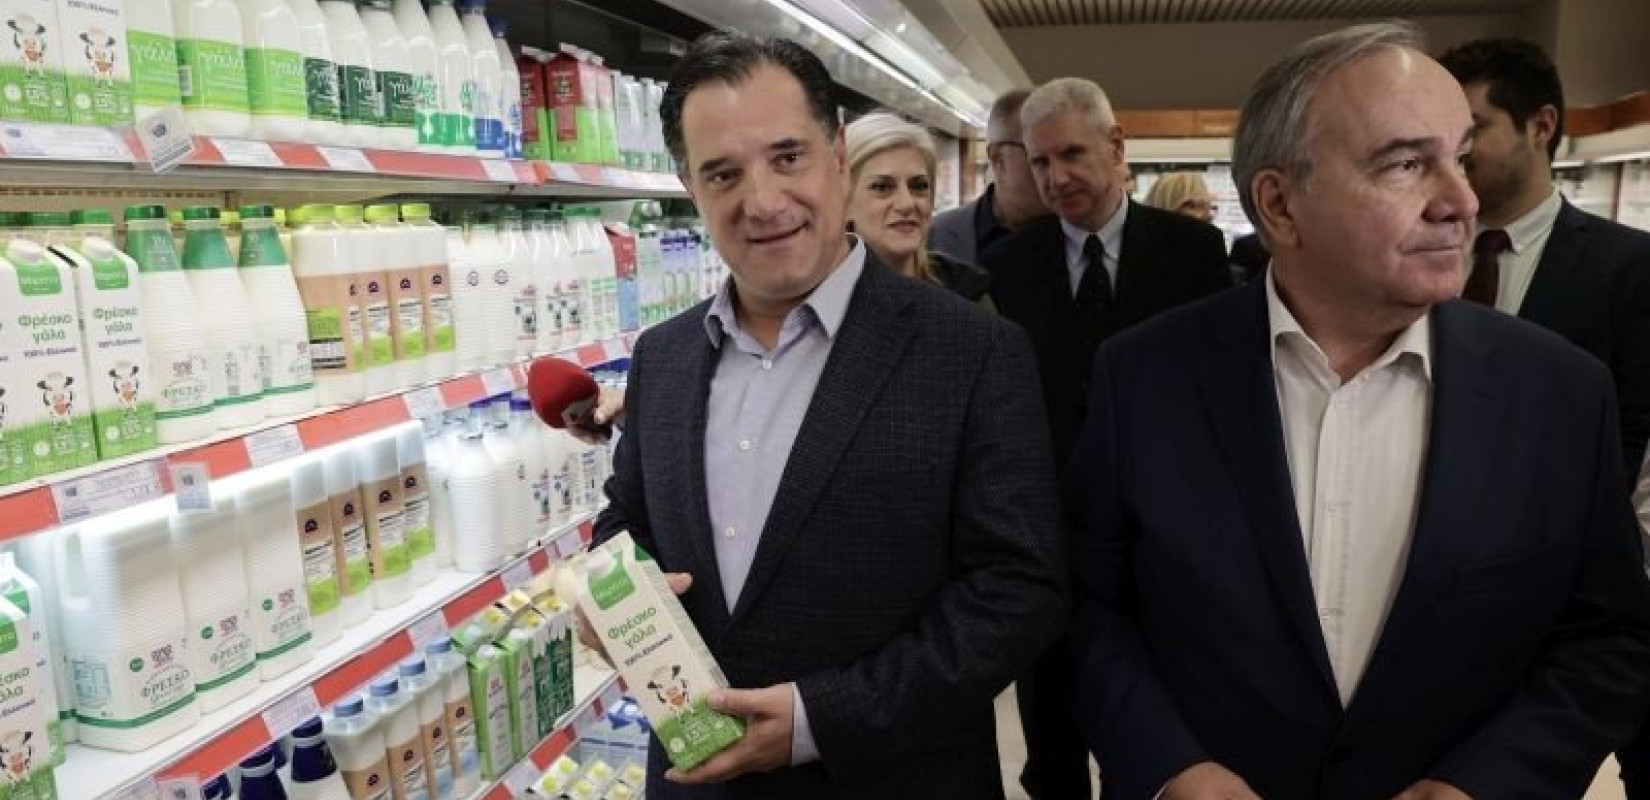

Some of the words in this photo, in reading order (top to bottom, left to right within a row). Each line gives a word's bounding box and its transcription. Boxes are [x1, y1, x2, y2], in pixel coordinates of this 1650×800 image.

[18, 313, 72, 330] Φρέσκο
[33, 328, 66, 345] γάλα
[608, 607, 656, 639] Φρέσκο
[625, 623, 657, 651] γάλα
